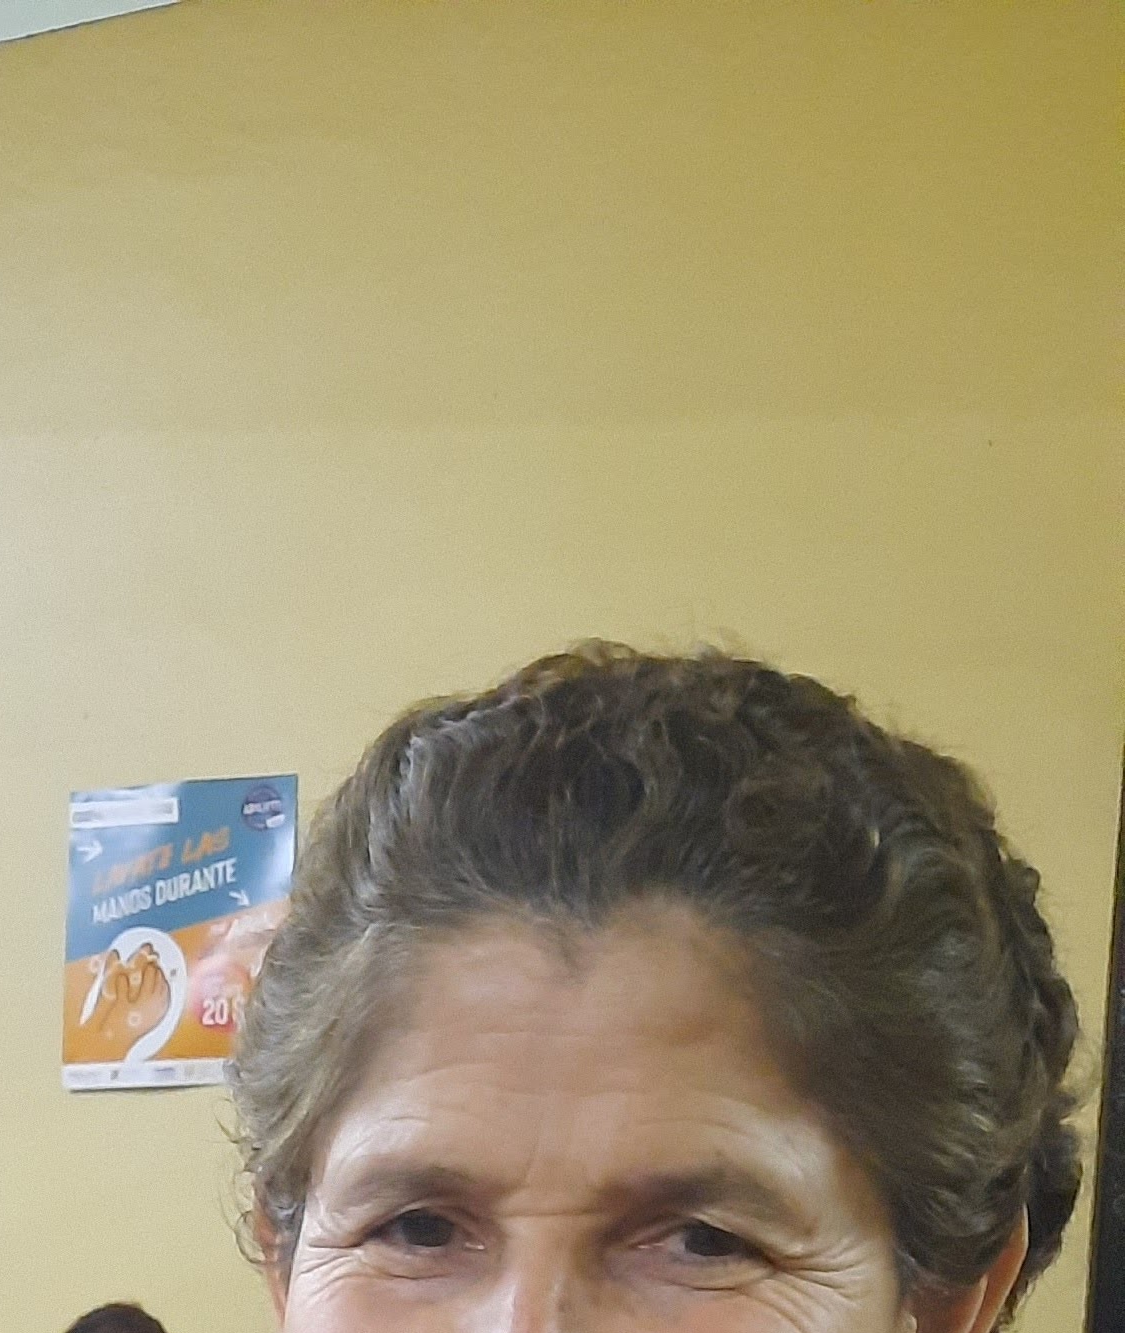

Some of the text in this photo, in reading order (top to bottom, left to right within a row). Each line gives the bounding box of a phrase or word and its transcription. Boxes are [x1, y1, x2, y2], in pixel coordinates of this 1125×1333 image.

[92, 857, 237, 924] MANOS DURANTE
[202, 999, 229, 1025] 20
